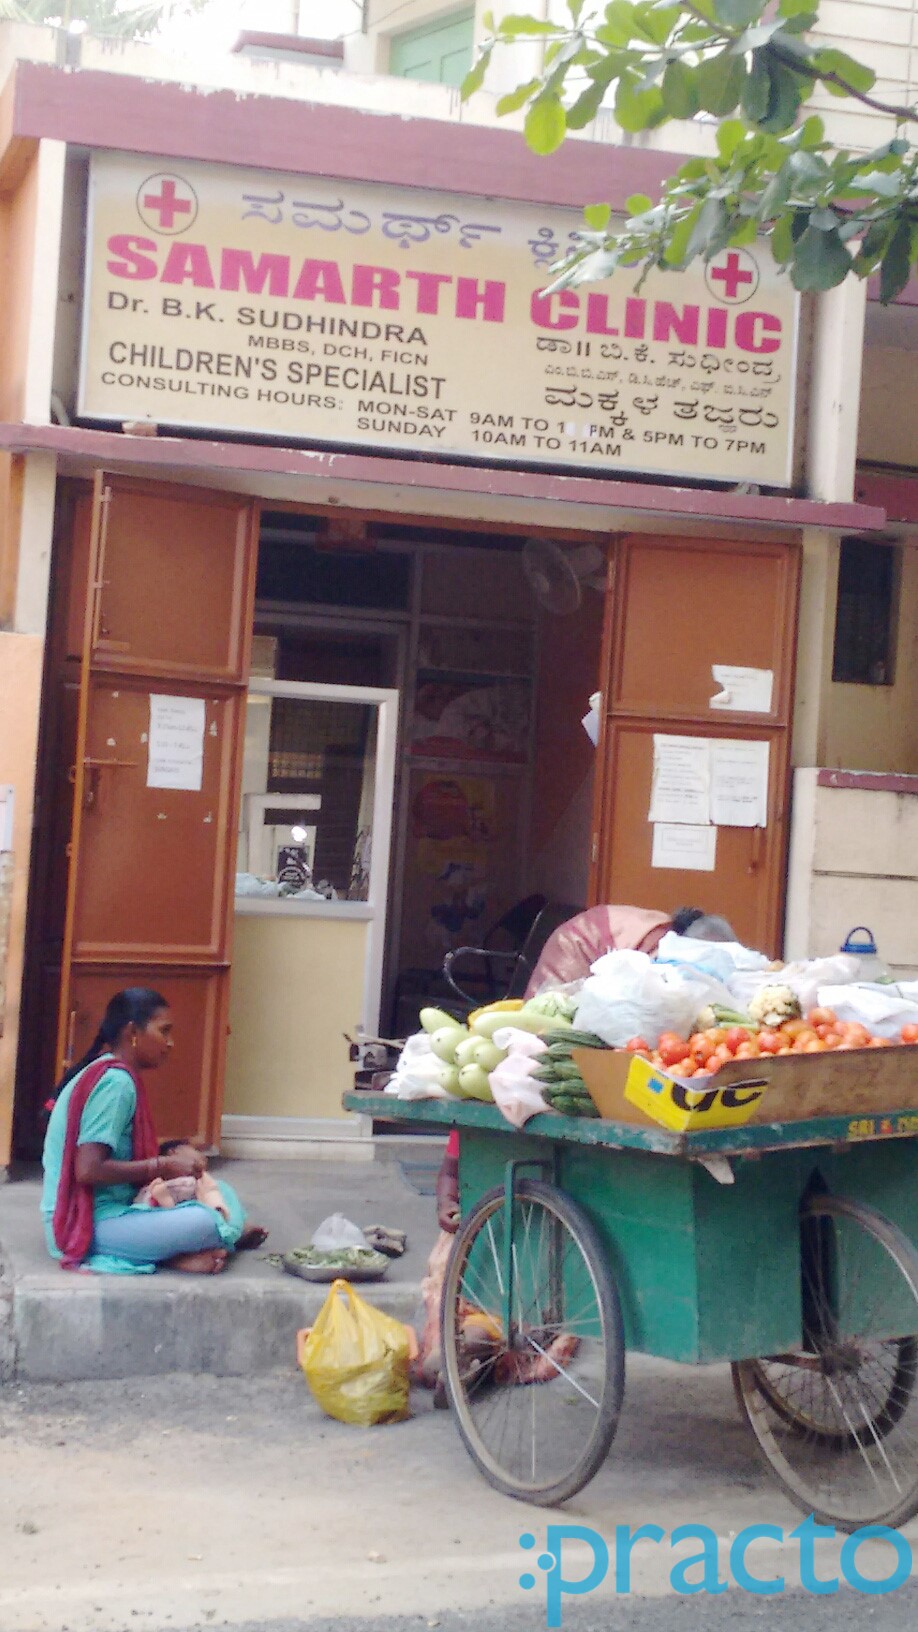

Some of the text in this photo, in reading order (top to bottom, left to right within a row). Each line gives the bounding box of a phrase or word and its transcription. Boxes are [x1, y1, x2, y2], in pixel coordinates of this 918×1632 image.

[106, 234, 506, 323] SAMARTH
[530, 287, 783, 354] CLINIC
[107, 291, 428, 346] Dr. B.K. SUDHINDRA
[109, 341, 446, 399] CHILDREN'S SPECIALIST
[248, 335, 429, 366] MBBS, DCH, FICN
[101, 372, 249, 400] CONSULTING
[257, 389, 344, 410] HOURS:
[357, 400, 457, 422] MON-SAT
[470, 411, 514, 430] 9AM
[522, 417, 549, 432] TO
[622, 428, 636, 441] &
[643, 430, 684, 446] 5PM
[691, 436, 718, 451] TO
[725, 439, 766, 455] 7PM
[357, 417, 622, 457] SUNDAY 10AM TO 11AM
